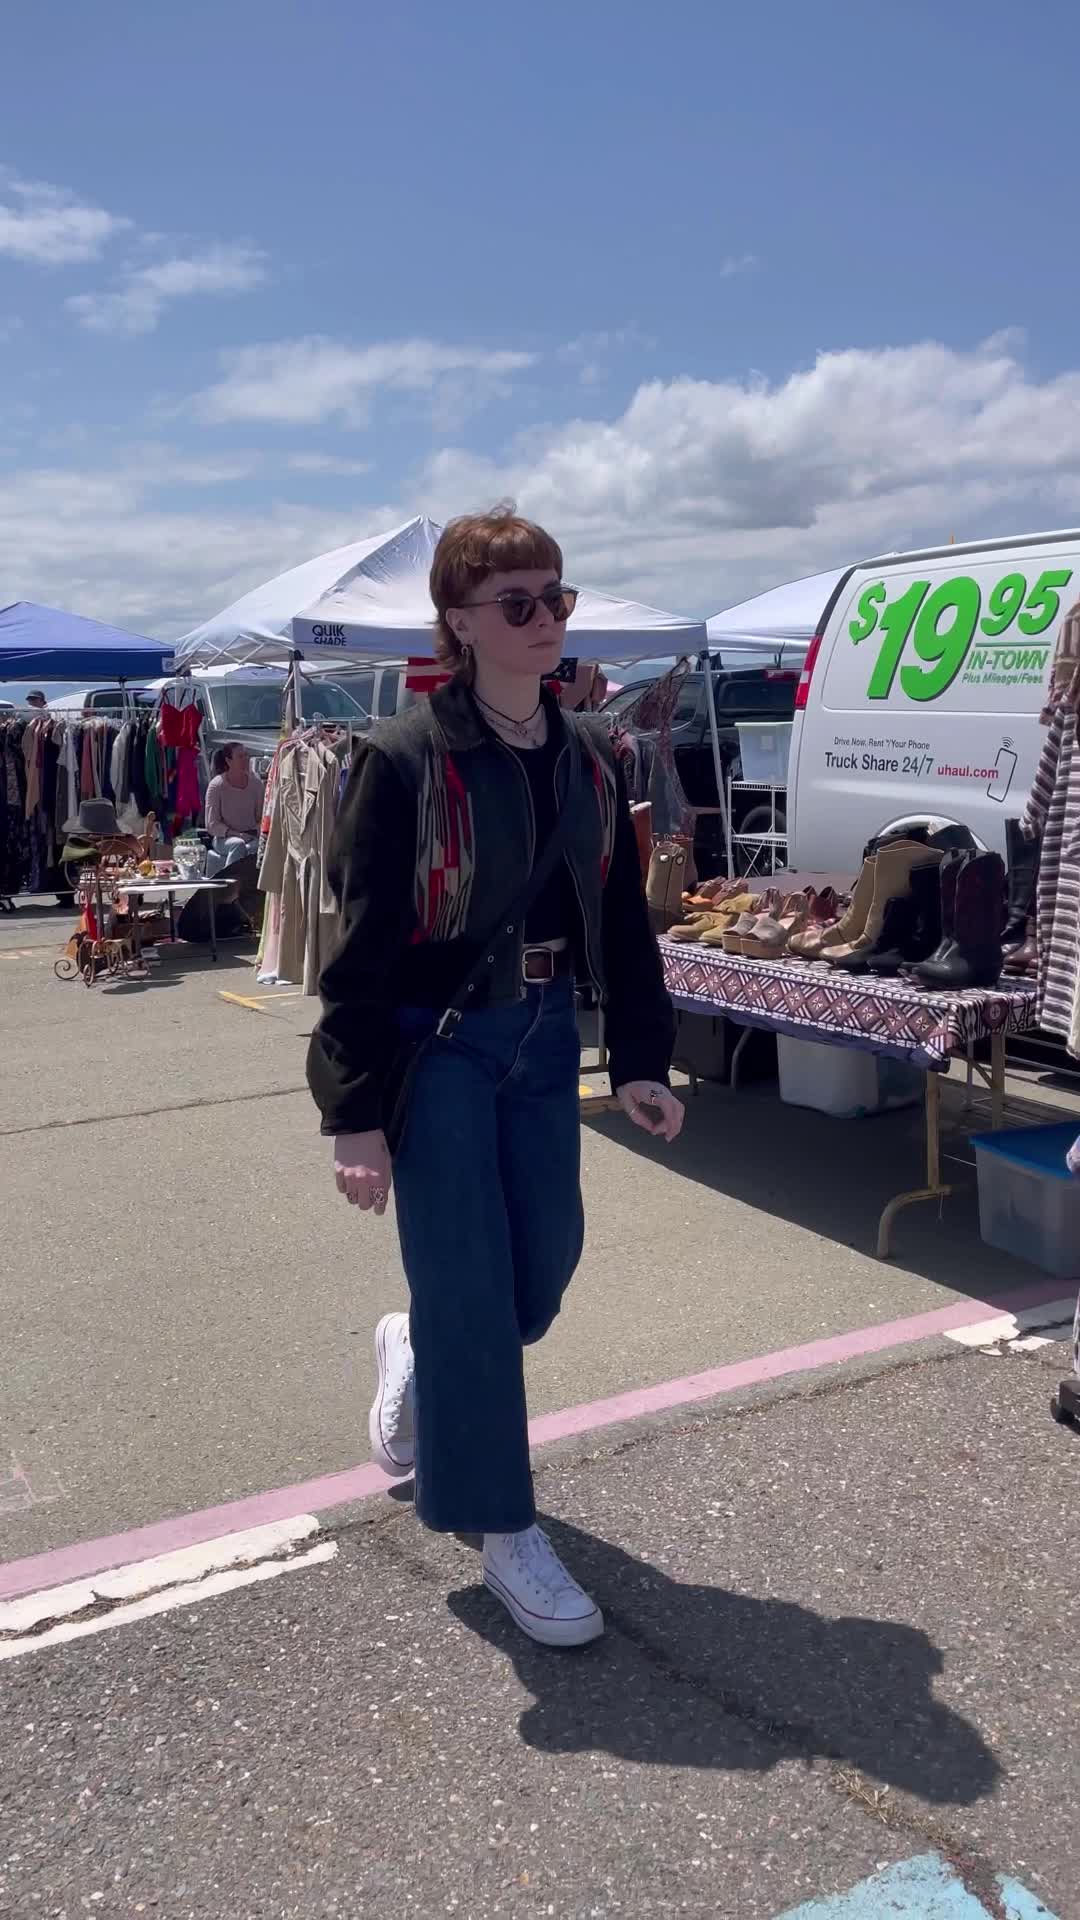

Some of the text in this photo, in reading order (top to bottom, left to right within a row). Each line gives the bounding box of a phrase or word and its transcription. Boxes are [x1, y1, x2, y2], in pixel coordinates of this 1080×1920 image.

[312, 624, 345, 636] QUIK
[314, 636, 347, 646] SHADE
[966, 649, 1049, 671] IN-TOWN
[962, 673, 980, 684] Plus
[834, 737, 850, 746] Drive
[868, 738, 884, 747] Rent
[908, 740, 930, 750] Phone
[825, 752, 934, 777] Truck Share 24/7
[937, 765, 999, 779] uhaul.com
